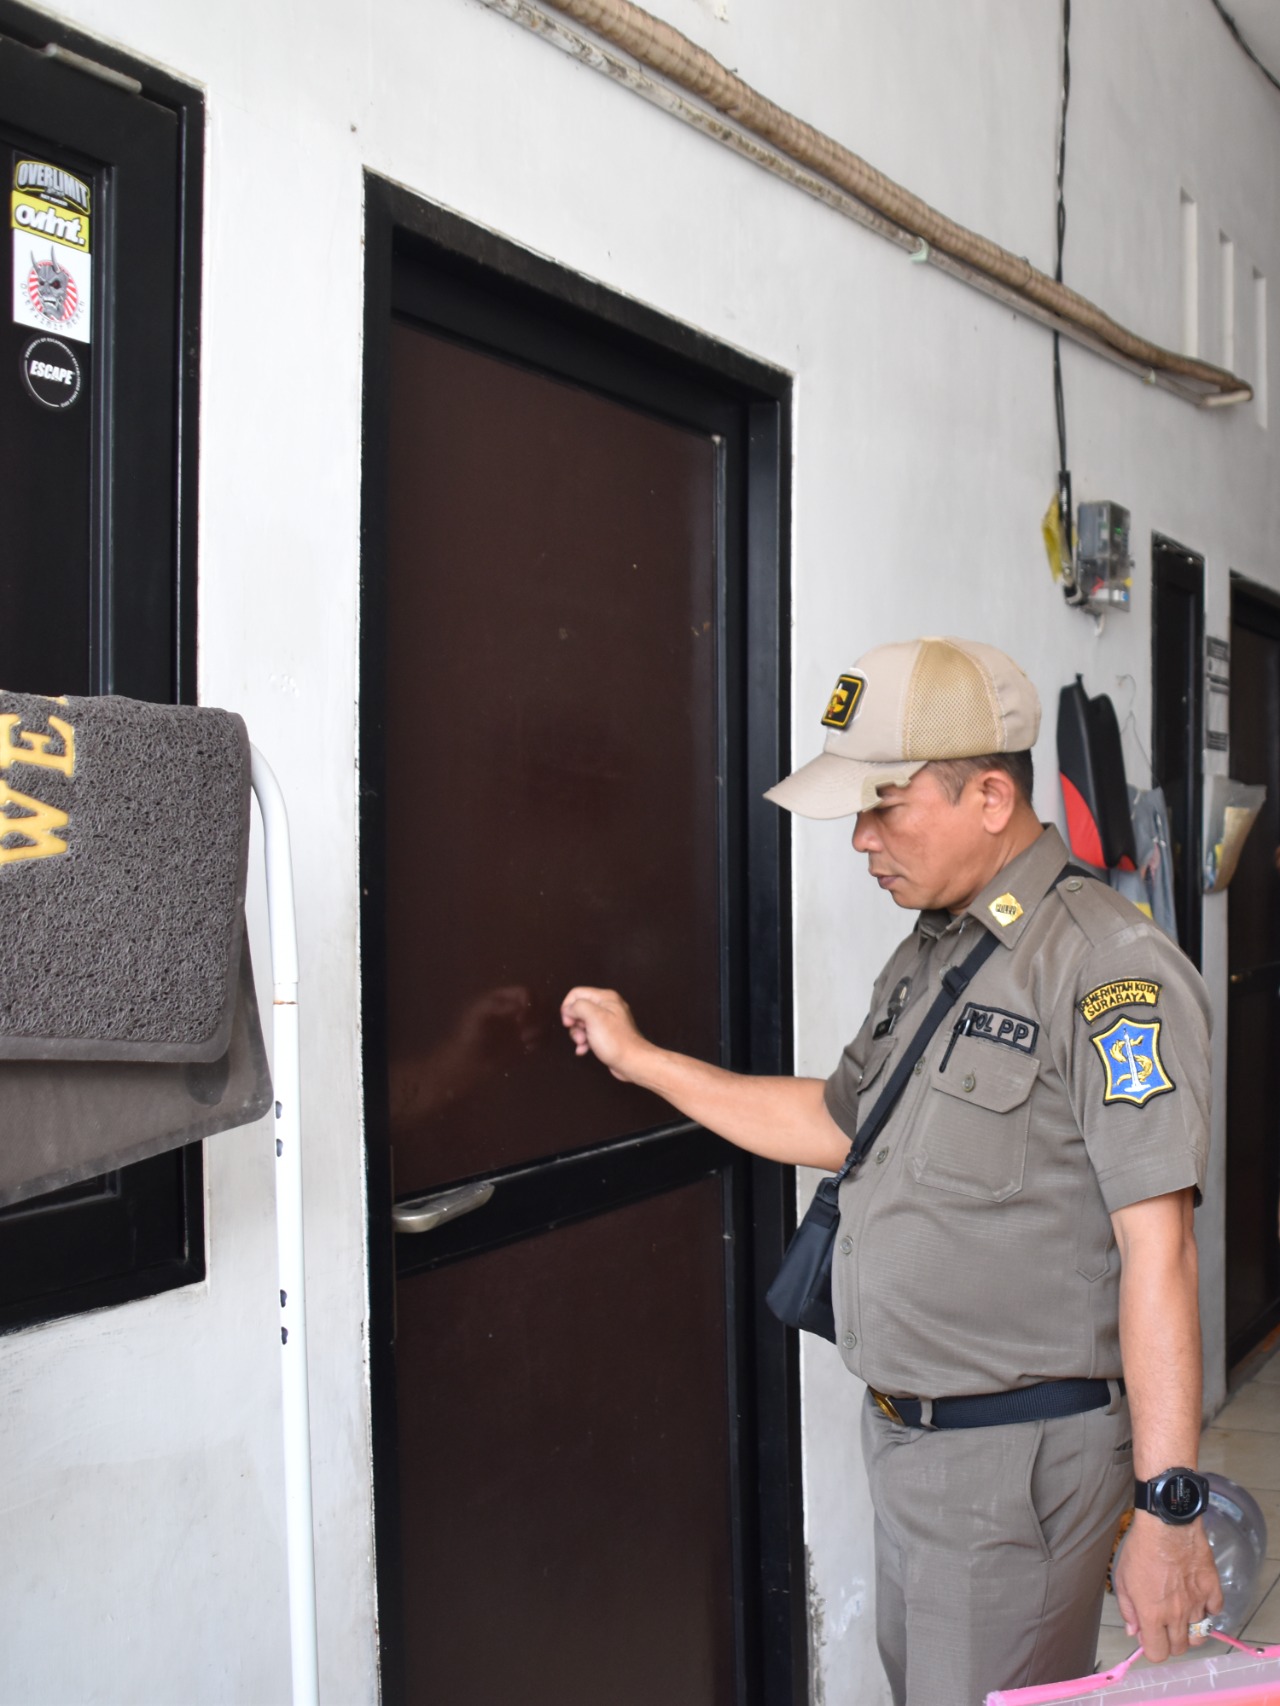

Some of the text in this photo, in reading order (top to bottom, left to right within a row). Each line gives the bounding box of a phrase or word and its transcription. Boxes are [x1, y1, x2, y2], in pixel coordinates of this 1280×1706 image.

[17, 163, 88, 209] OVERLIMIT
[30, 360, 73, 385] ESCAPE
[0, 696, 75, 864] WE
[1080, 982, 1157, 1012] PEMERINTAH KOTA
[1087, 992, 1147, 1017] SURABAYA
[998, 1018, 1029, 1043] PP
